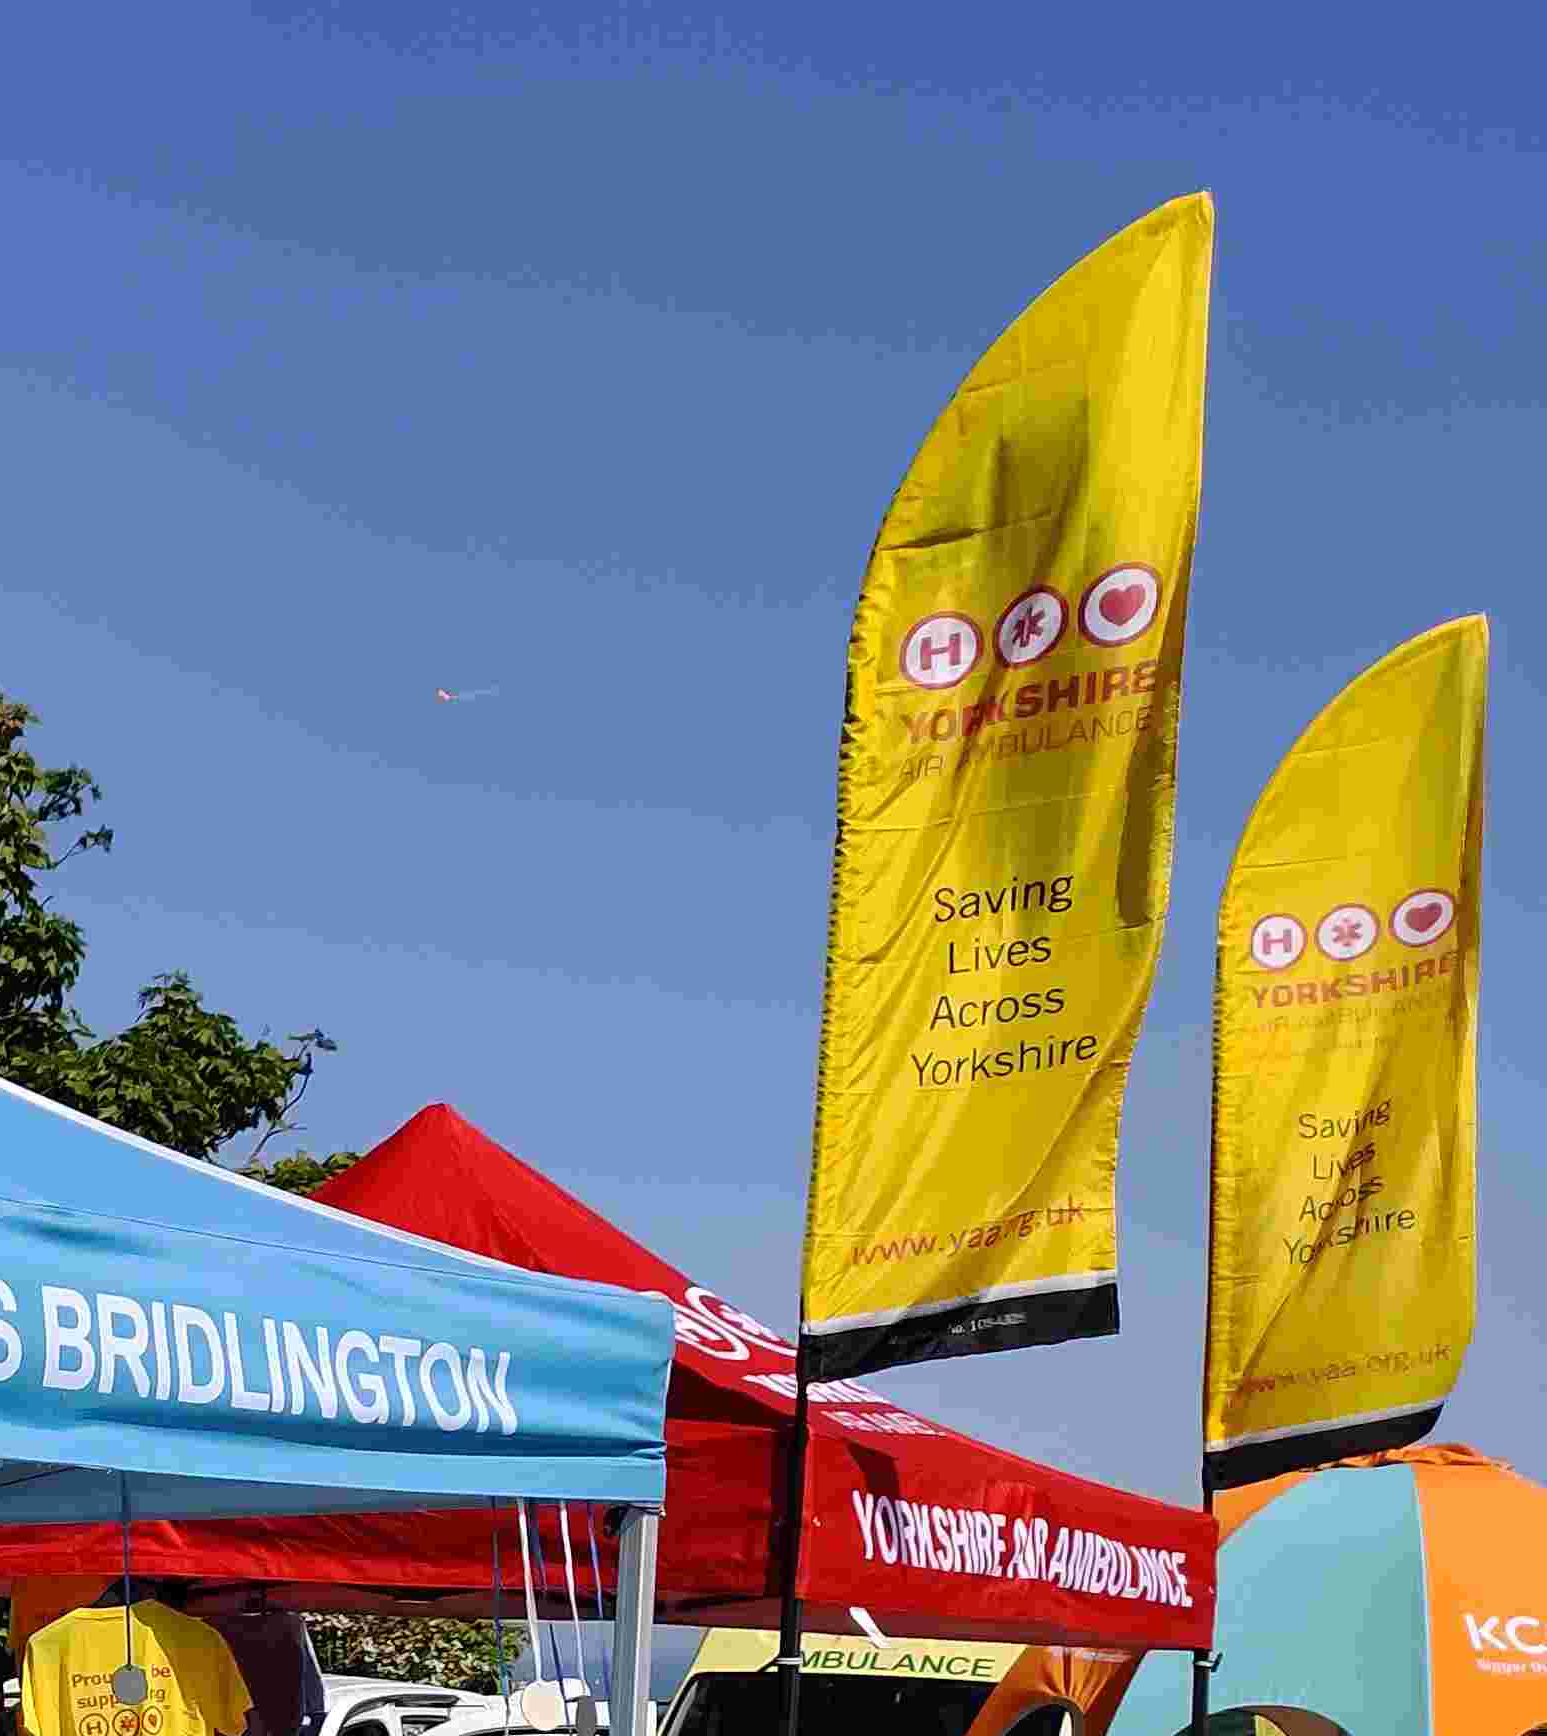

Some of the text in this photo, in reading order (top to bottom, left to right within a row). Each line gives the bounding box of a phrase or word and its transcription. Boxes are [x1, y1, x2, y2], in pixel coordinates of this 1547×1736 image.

[934, 874, 1075, 923] Saving
[948, 935, 1052, 975] Lives
[930, 987, 1066, 1031] Across
[911, 1034, 1099, 1088] Yorkshire
[1298, 1096, 1393, 1138] Saving
[42, 1285, 520, 1436] BRIDLINGTON
[851, 1489, 1194, 1608] YORKSHIRE AIR AMBULANCE
[151, 1664, 171, 1678] be
[801, 1650, 996, 1678] MBULANCE
